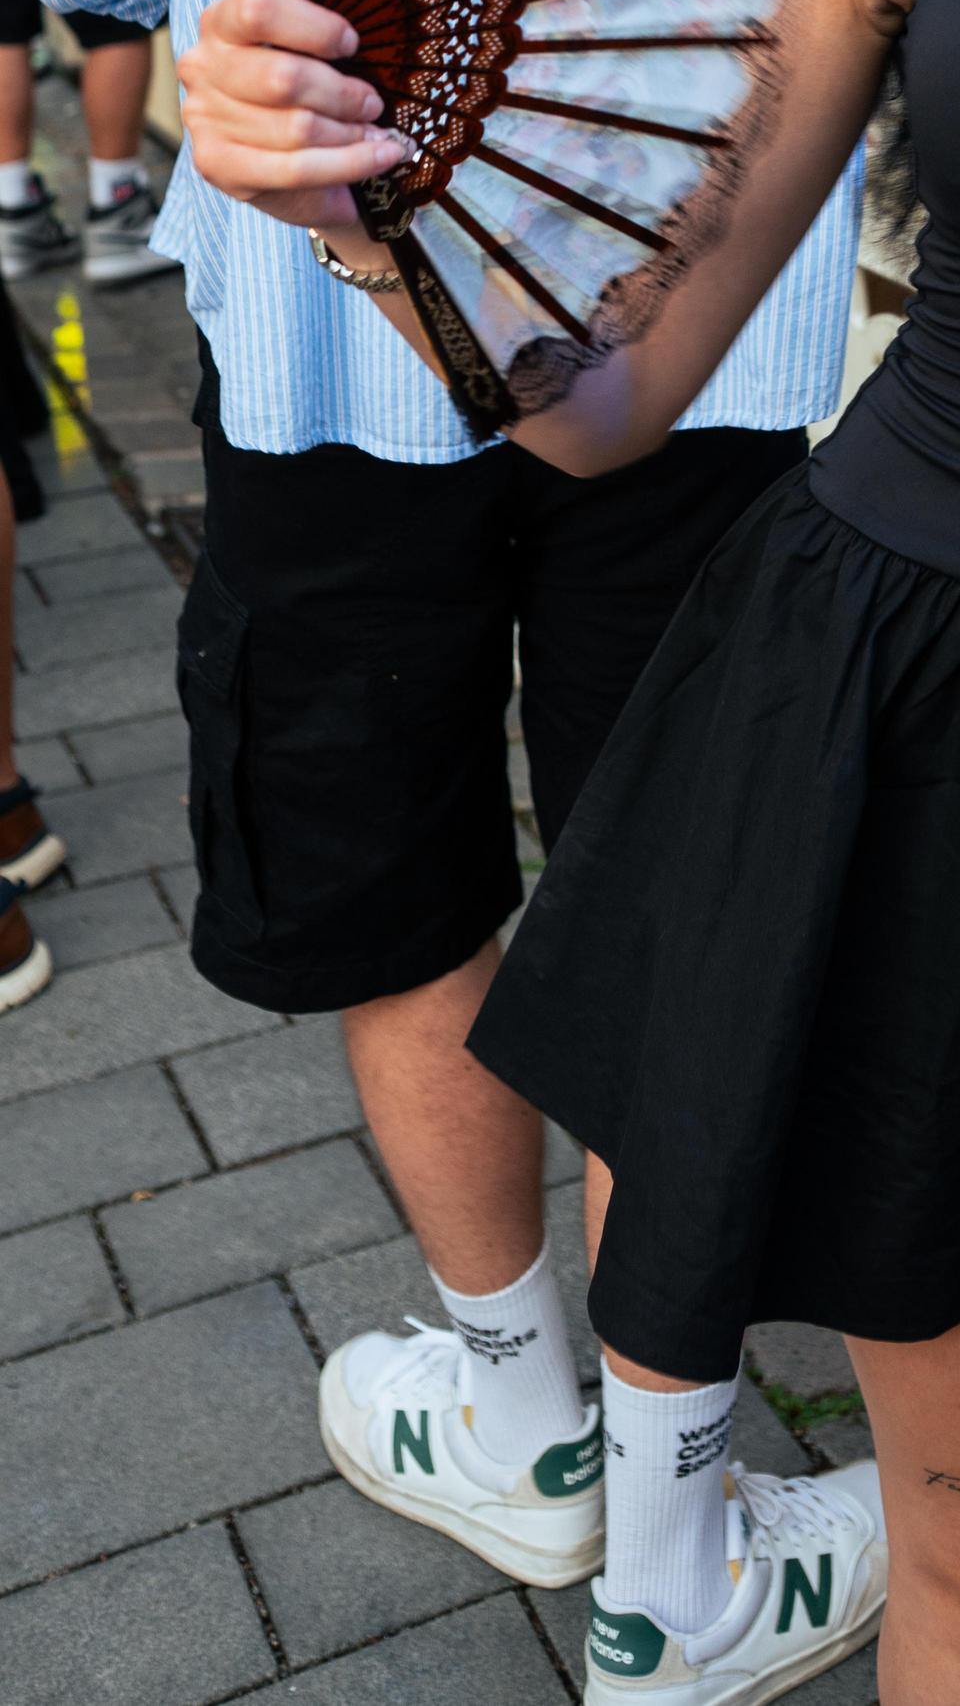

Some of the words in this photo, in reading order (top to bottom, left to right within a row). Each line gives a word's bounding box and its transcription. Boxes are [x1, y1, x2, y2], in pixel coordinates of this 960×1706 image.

[393, 1409, 435, 1475] N
[775, 1553, 832, 1635] N
[592, 1616, 621, 1641] new
